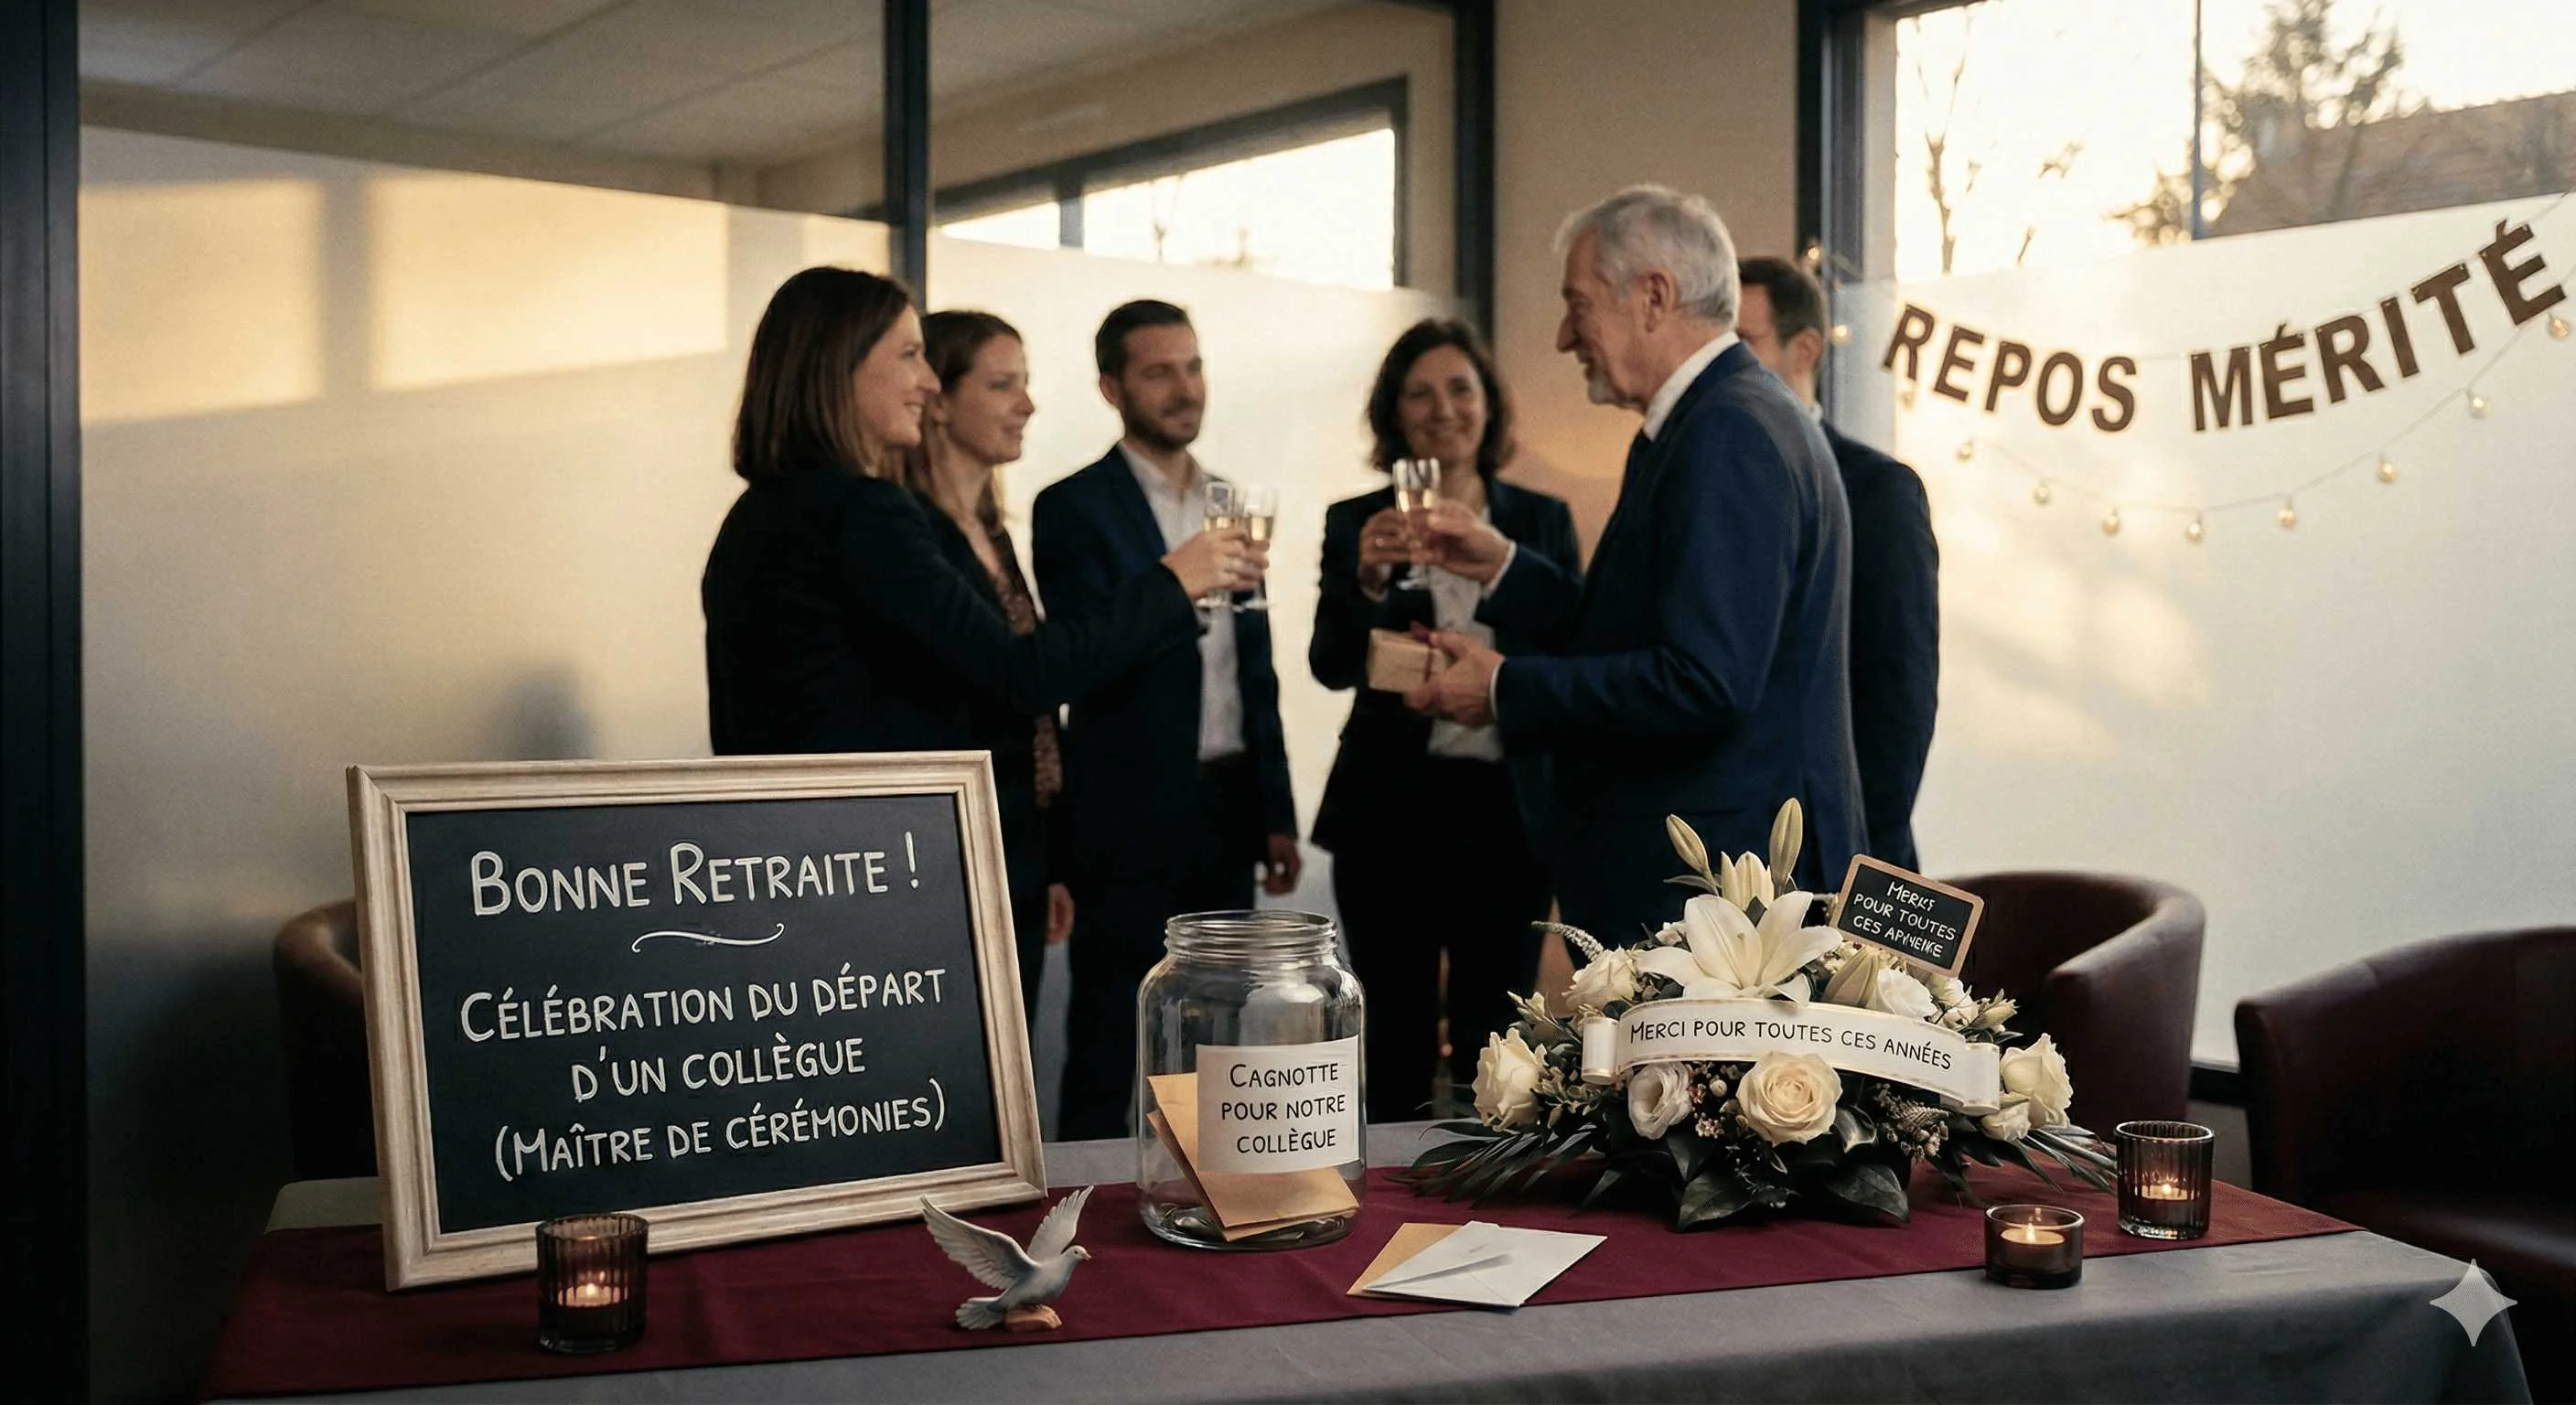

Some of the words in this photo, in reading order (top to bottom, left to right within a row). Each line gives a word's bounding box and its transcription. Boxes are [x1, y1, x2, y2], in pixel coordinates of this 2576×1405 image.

[1883, 302, 2138, 433] REPOS
[2192, 219, 2567, 433] MÉRITÉ
[470, 851, 650, 917] BONNE
[669, 842, 889, 906] RETRAITE
[904, 831, 919, 889] !
[1853, 893, 1894, 918] POUR
[1899, 908, 1957, 941] TOUTES
[460, 984, 734, 1043] CÉLÉBRATION
[748, 981, 798, 1022] DU
[812, 962, 946, 1016] DÉPART
[571, 1046, 667, 1103] D'UN
[682, 1032, 866, 1090] COLLÈGUE
[1229, 1063, 1338, 1088] CAGNOTTE
[1630, 1021, 1686, 1044] MERCI
[1693, 1021, 1746, 1039] POUR
[1756, 1022, 1833, 1044] TOUTES
[1841, 1030, 1876, 1051] CES
[1884, 1039, 1953, 1070] ANNÉES
[495, 1123, 653, 1182] (MAÎTRE
[668, 1121, 712, 1160] DE
[725, 1078, 946, 1150] CÉRÉMONIES)
[1221, 1102, 1277, 1121] POUR
[1286, 1094, 1346, 1120] NOTRE
[1237, 1128, 1336, 1153] COLLÈGUE
